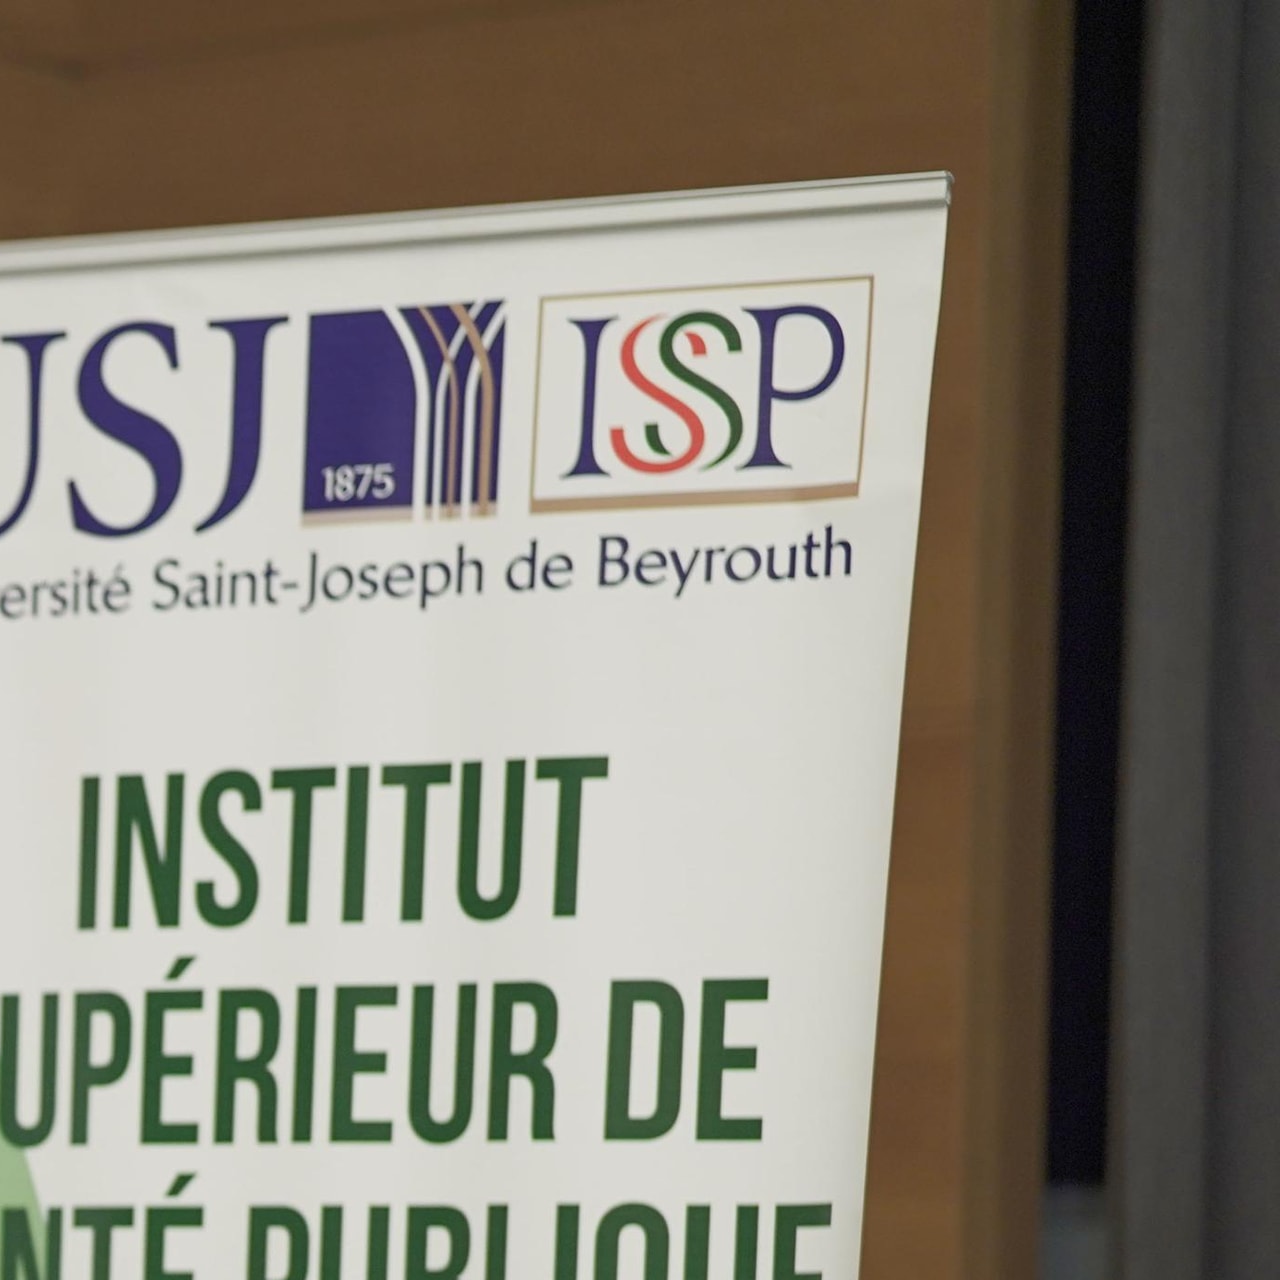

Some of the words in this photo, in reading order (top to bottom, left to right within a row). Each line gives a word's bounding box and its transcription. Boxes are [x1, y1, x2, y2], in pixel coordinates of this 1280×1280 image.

[559, 304, 846, 480] ISSP
[321, 463, 395, 501] 1875
[152, 540, 484, 612] Saint-Joseph
[505, 538, 573, 593] de
[597, 522, 853, 599] Beyrouth
[77, 755, 609, 930] INSTITUT
[603, 977, 770, 1142] DE
